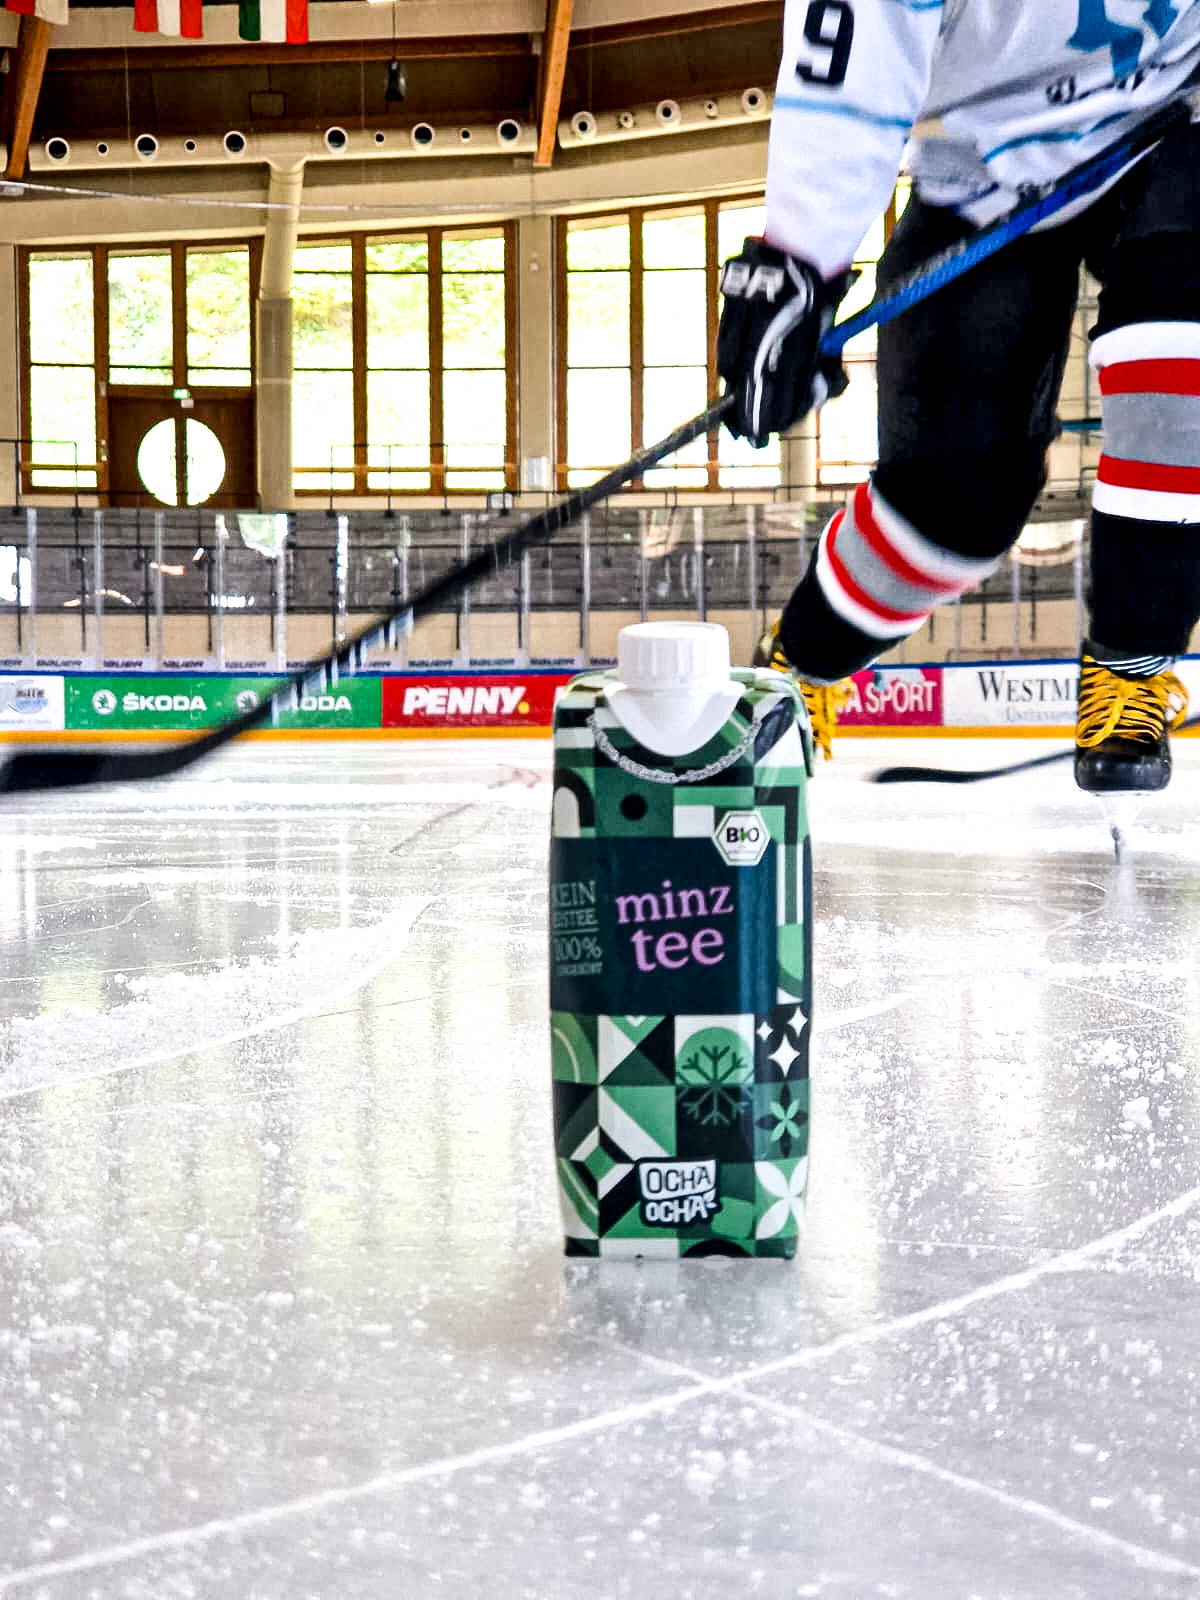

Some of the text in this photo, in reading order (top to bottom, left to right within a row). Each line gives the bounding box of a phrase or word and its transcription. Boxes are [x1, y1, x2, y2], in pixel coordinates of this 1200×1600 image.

[796, 0, 854, 87] 9
[122, 691, 208, 711] ŠKODA
[866, 680, 938, 714] SPORT
[615, 880, 734, 924] minz
[630, 928, 725, 972] tee
[646, 1165, 712, 1194] OCHA
[645, 1195, 709, 1223] OCHA
